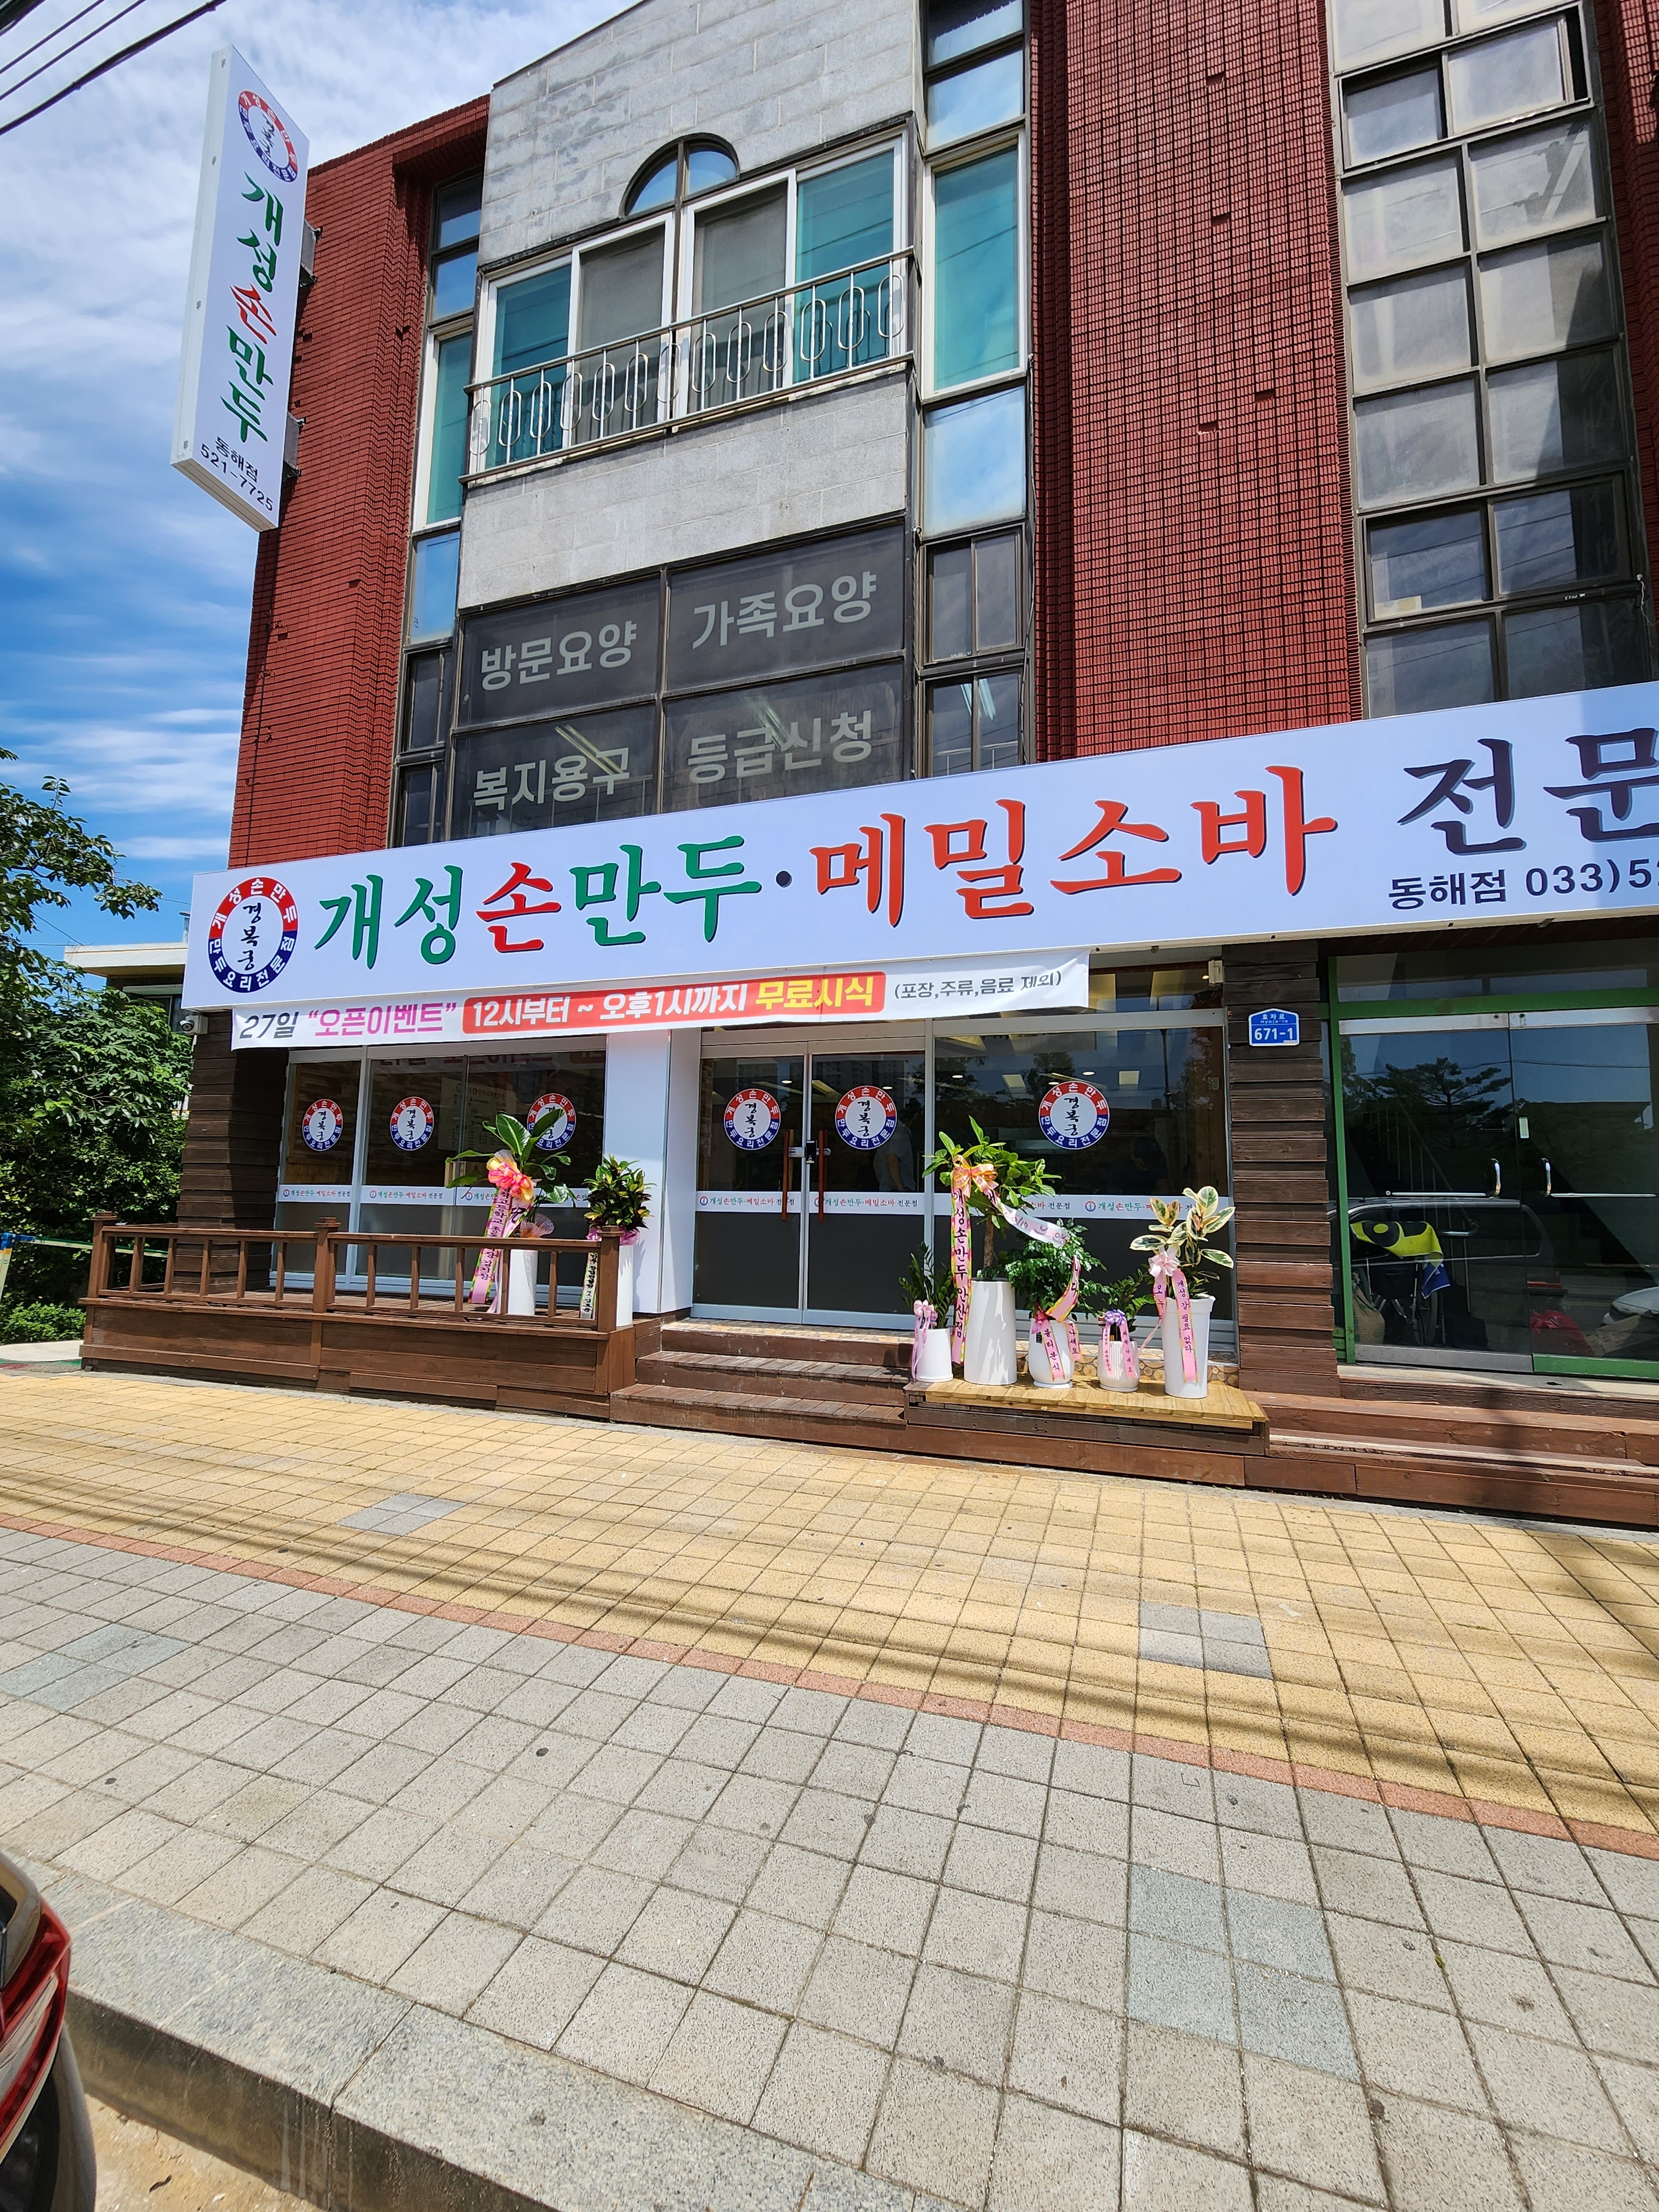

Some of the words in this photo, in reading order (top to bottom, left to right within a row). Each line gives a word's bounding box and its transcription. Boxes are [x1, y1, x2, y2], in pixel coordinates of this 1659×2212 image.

[220, 170, 283, 445] 개성손만두
[200, 443, 274, 512] 521-7725
[215, 436, 258, 483] 동해점
[692, 570, 877, 650] 가족요양
[480, 620, 638, 691] 방문요양
[687, 709, 872, 785] 등급신청
[473, 747, 630, 811] 복지용구
[212, 878, 298, 930] 개성손만두
[1388, 869, 1507, 910] 동해점
[1525, 858, 1659, 897] 033)5
[237, 902, 262, 971] 경복궁
[210, 936, 295, 992] 만두요리전문점
[239, 1010, 300, 1040] 27일
[472, 996, 571, 1027] 12시부터
[599, 983, 749, 1021] 오후1시까지
[754, 975, 874, 1010] 무료시식
[1019, 969, 1062, 994] 제외)
[1254, 1027, 1293, 1040] 671-1
[726, 1090, 779, 1115] 개성손만두
[744, 1102, 757, 1138] 경복궁
[837, 1087, 895, 1114] 개성손만두
[857, 1100, 872, 1138] 경복궁
[1041, 1082, 1107, 1111] 개성손만두
[1063, 1096, 1080, 1136] 경복궁
[726, 1119, 779, 1149] 만두요리전문점
[837, 1118, 895, 1147] 만두요리전문점
[1041, 1115, 1107, 1147] 만두요리전문점
[898, 1199, 918, 1207] 전문점
[1047, 1201, 1070, 1210] 전문점
[953, 1190, 968, 1281] 개성손만두
